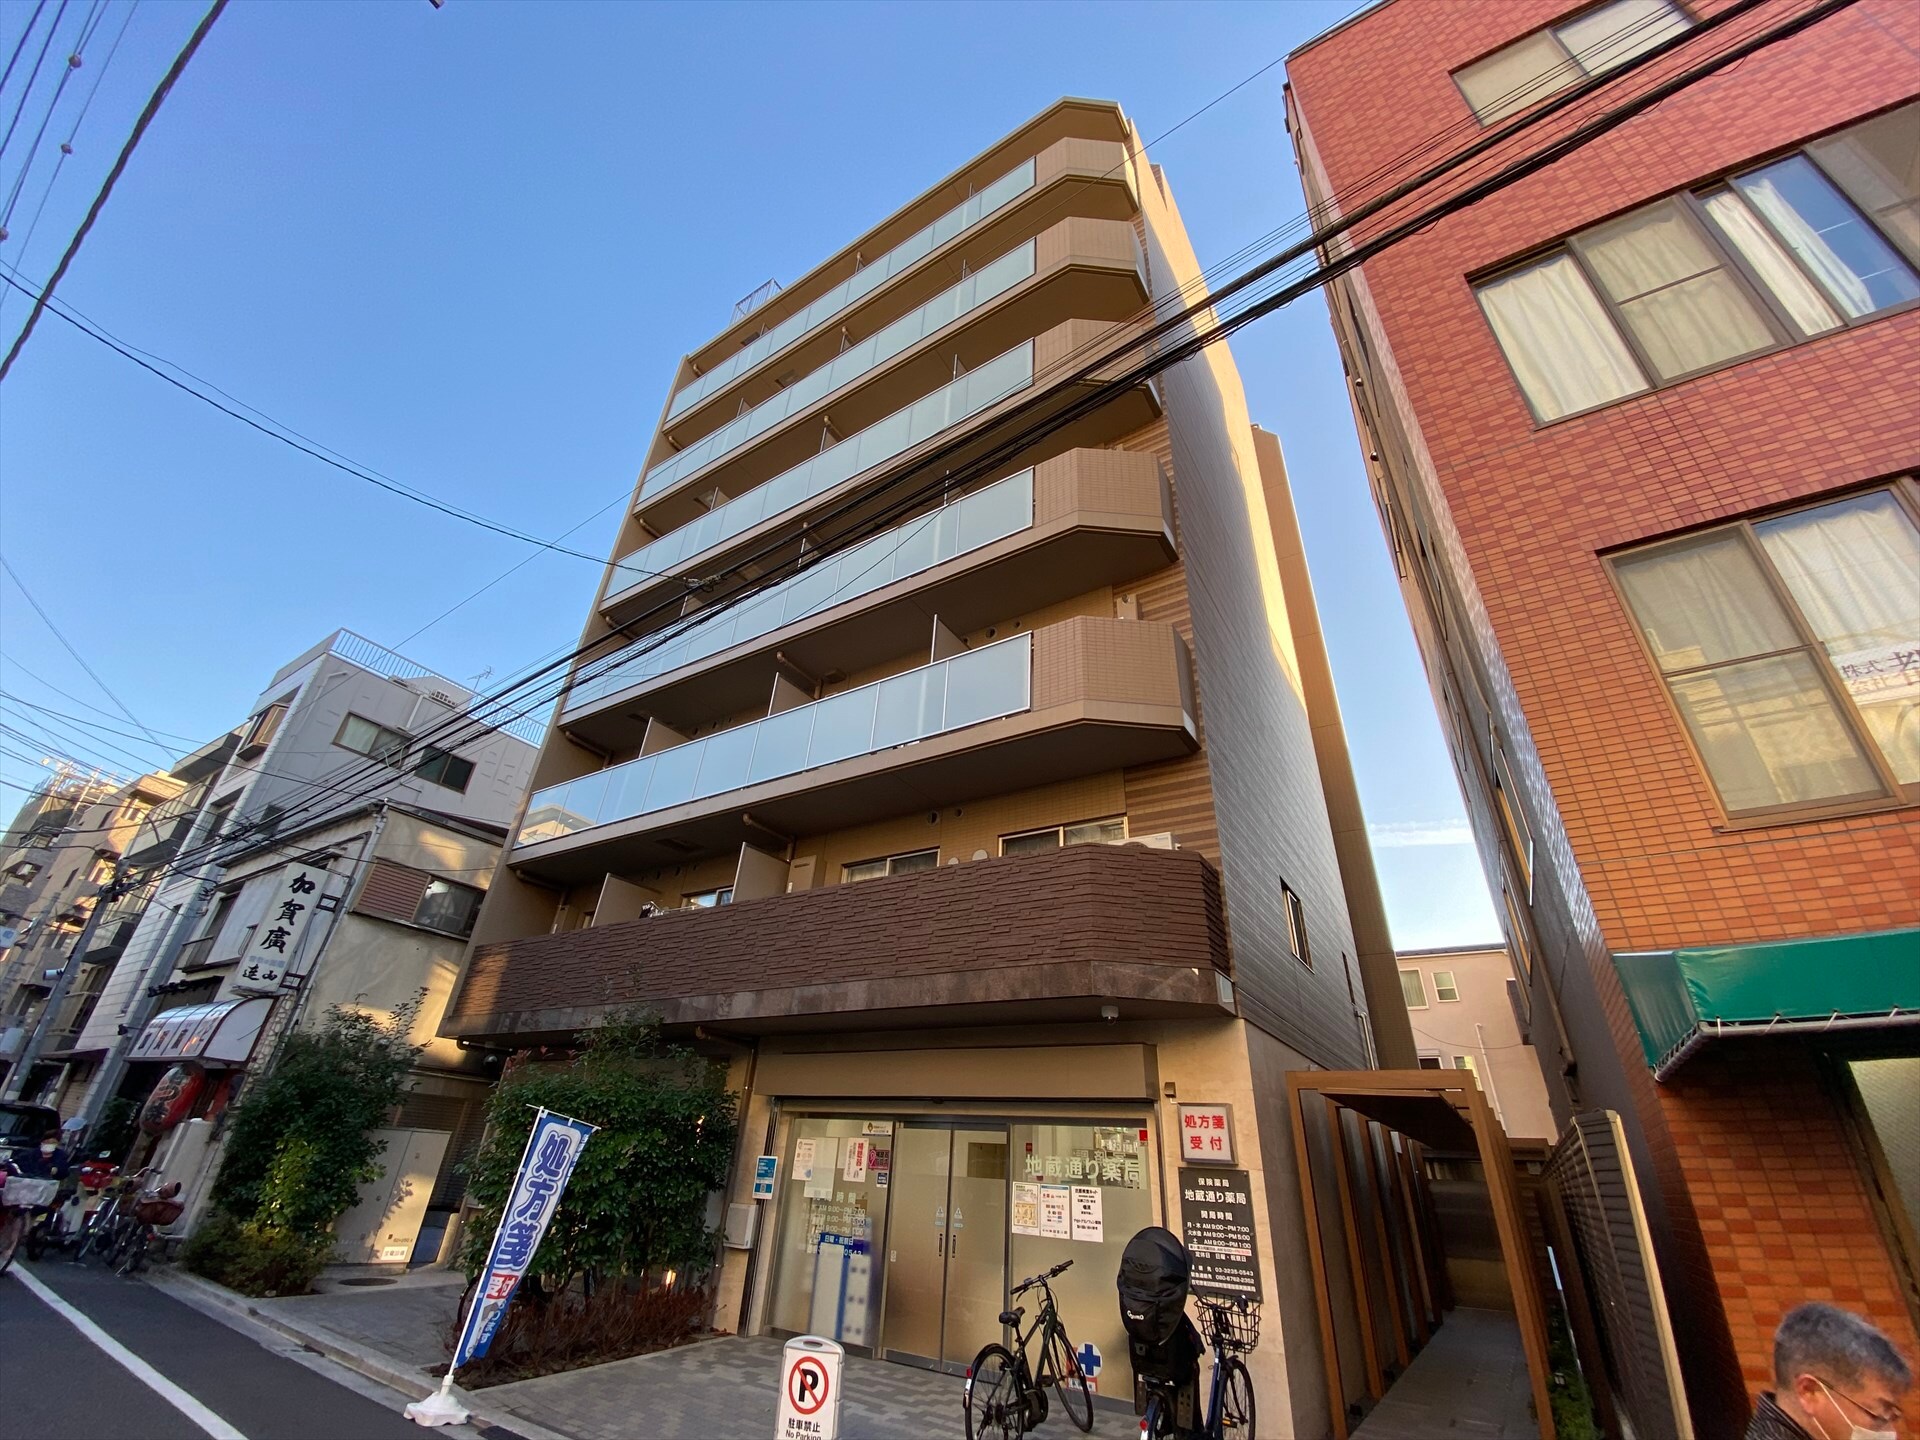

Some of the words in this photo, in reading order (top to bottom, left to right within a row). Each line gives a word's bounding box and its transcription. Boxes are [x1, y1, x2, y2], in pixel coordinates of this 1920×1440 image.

[260, 871, 317, 955] 加賀廣
[1184, 1115, 1225, 1130] 処方箋
[1189, 1136, 1224, 1152] 受付
[1025, 1153, 1140, 1182] 地蔵通り薬局
[493, 1130, 573, 1272] 処方箋
[1184, 1189, 1247, 1205] 地蔵通り薬局
[788, 1418, 821, 1432] 駐車禁止
[785, 1429, 795, 1439] No
[795, 1431, 822, 1440] Parking
